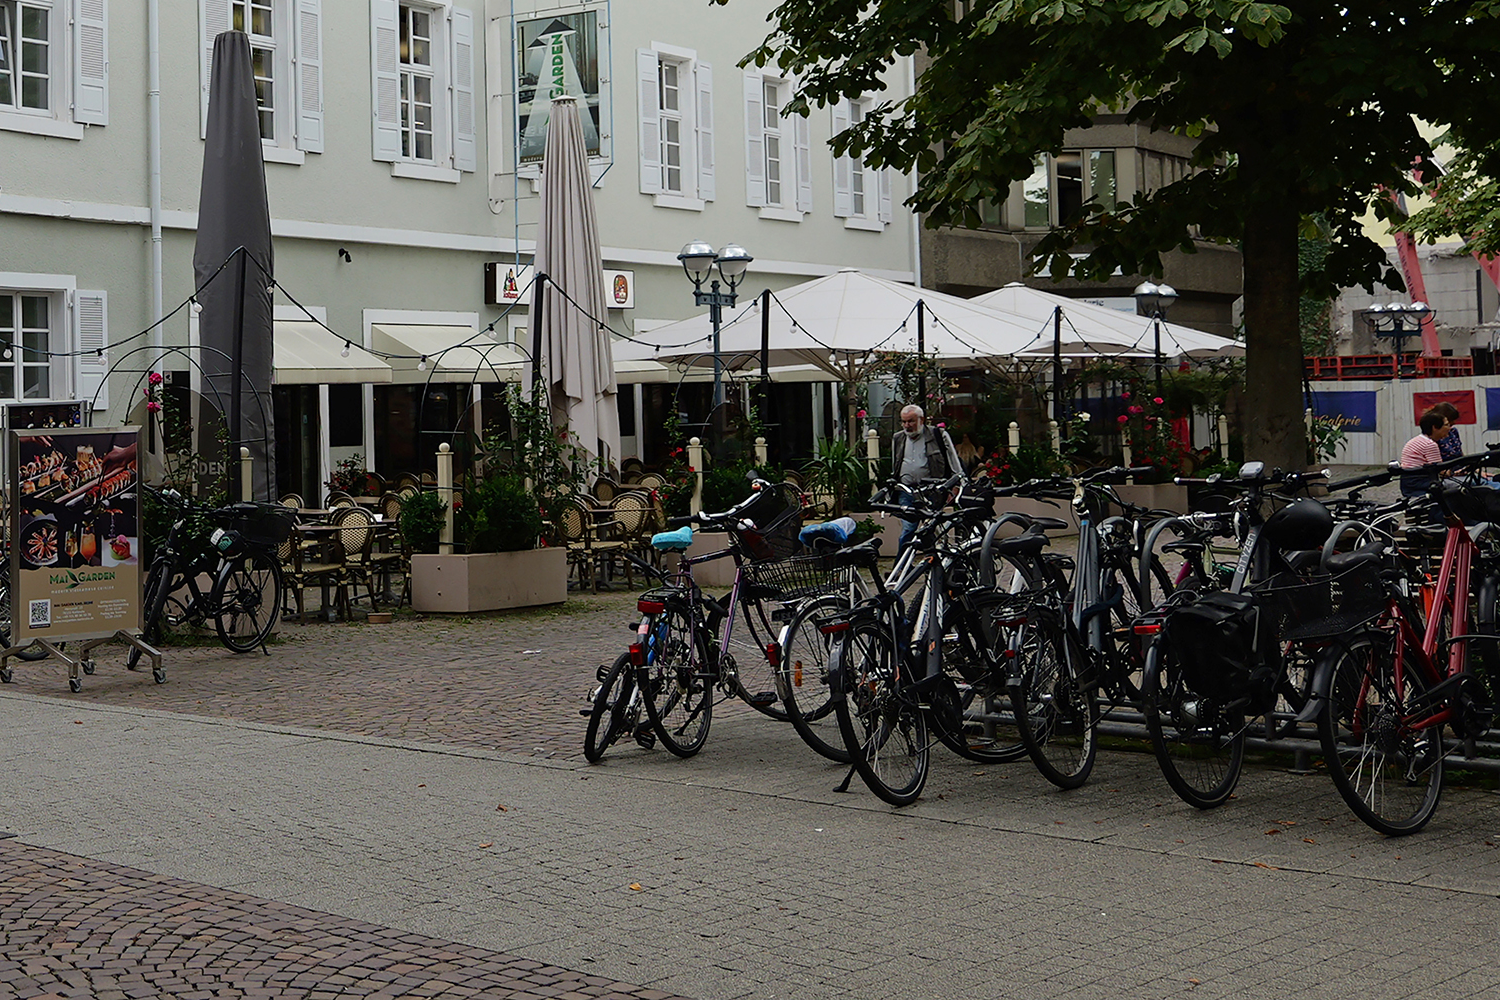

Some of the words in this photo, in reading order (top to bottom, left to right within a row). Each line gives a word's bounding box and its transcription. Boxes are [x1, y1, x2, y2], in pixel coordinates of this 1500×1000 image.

[549, 34, 564, 99] GARDEN
[1319, 413, 1362, 426] Galerie
[1236, 532, 1256, 574] CITYZEN
[49, 574, 69, 585] MAI
[78, 571, 116, 582] GARDEN
